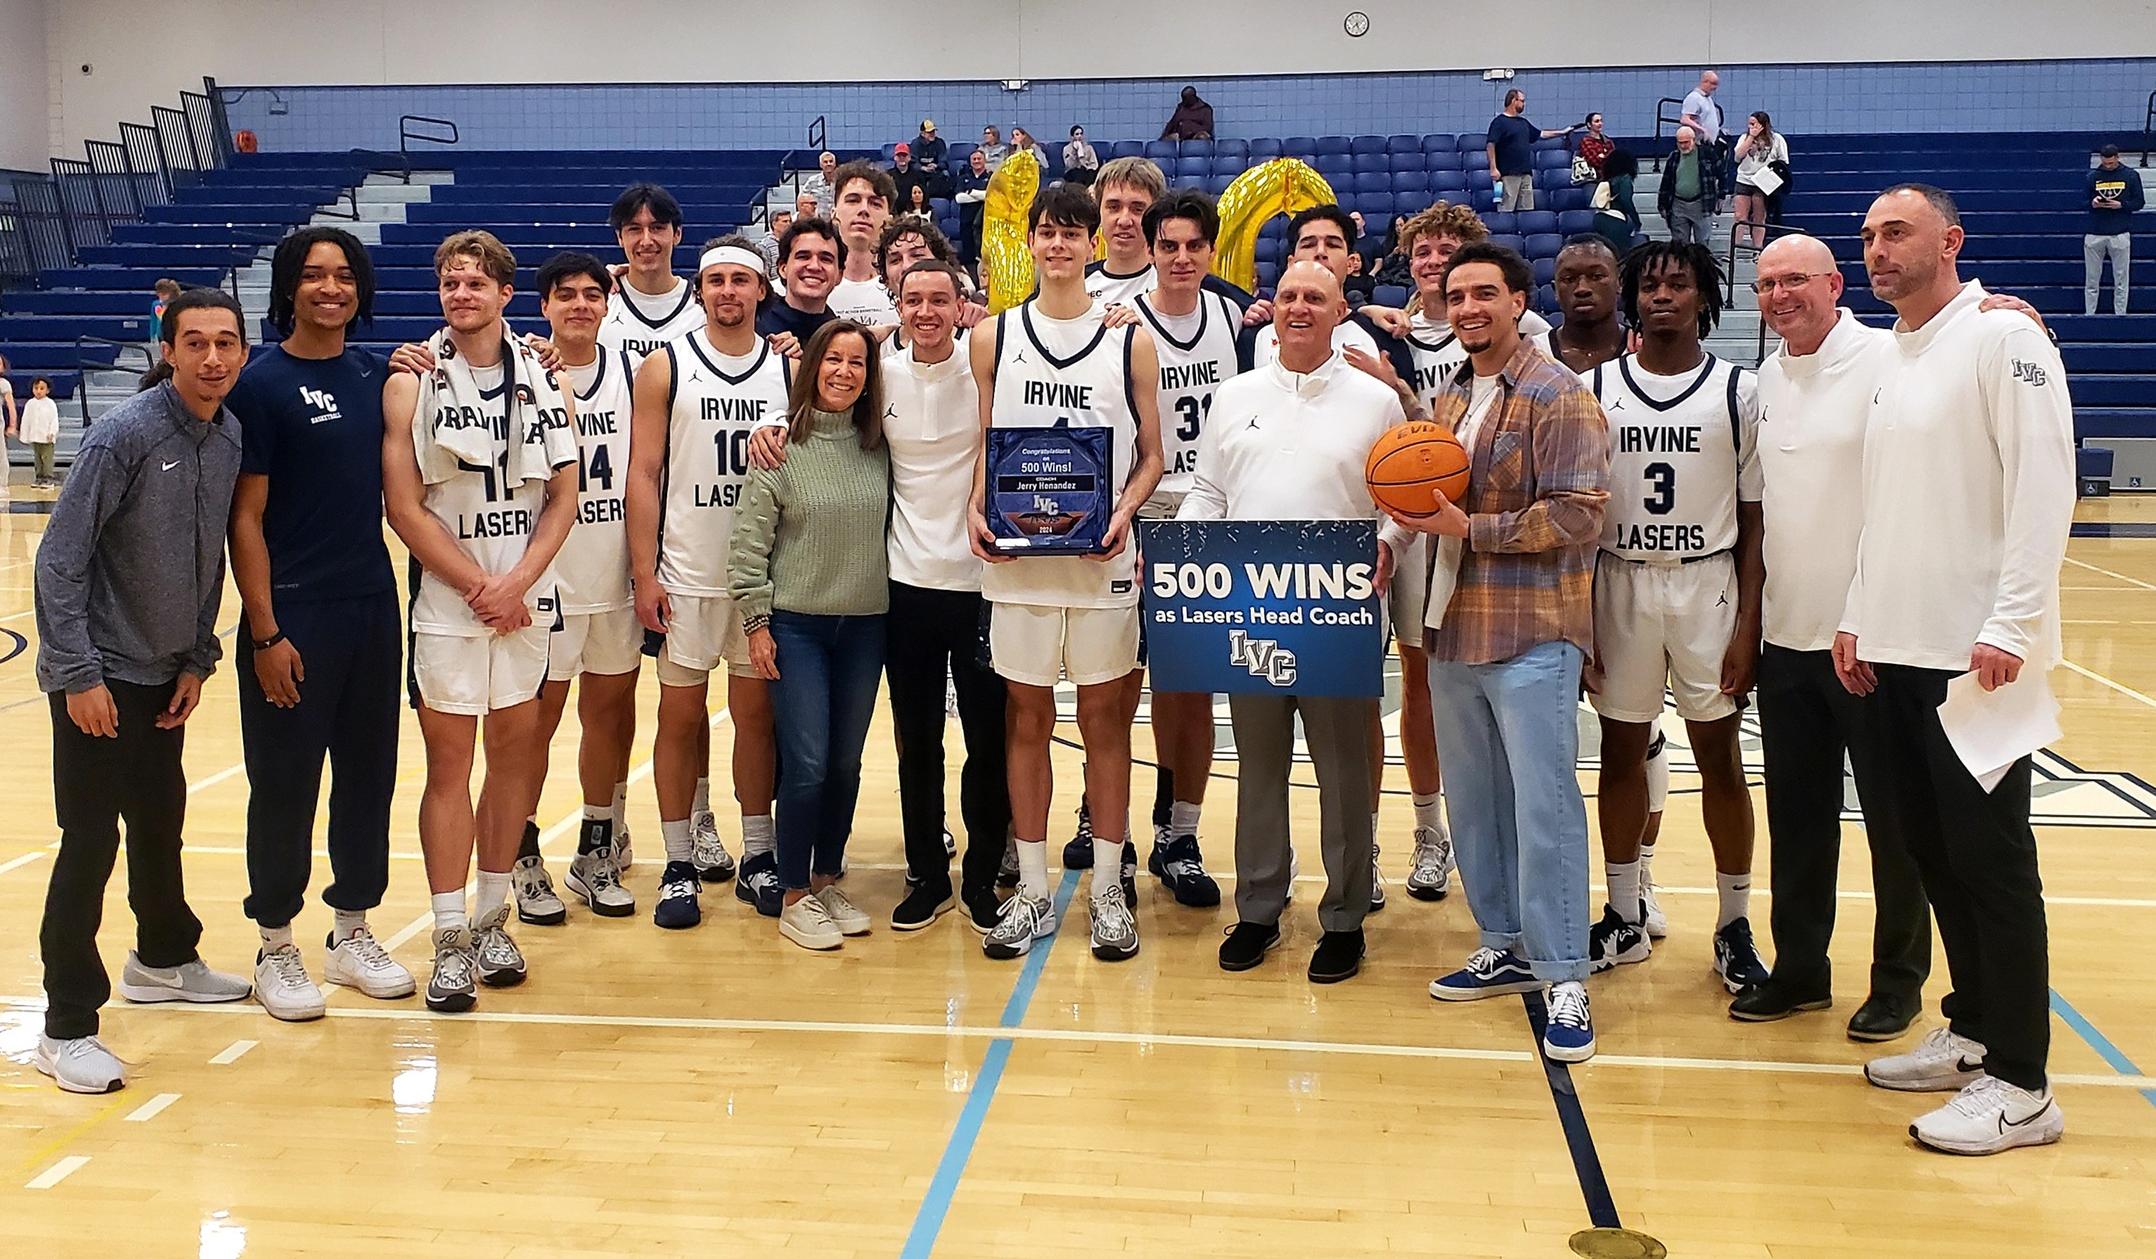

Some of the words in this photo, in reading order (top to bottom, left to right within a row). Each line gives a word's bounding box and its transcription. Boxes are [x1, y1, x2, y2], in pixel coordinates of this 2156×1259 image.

[1161, 360, 1221, 390] IRVINE
[2011, 359, 2046, 387] IVC
[299, 385, 338, 412] IVC
[701, 397, 768, 421] IRVINE
[1024, 380, 1093, 411] IRVINE
[576, 411, 618, 437] VINE
[714, 429, 751, 475] 10
[1620, 426, 1702, 453] IRVINE
[1021, 462, 1040, 473] 500
[1042, 461, 1072, 473] Wins!
[1017, 481, 1037, 492] Jerry
[1039, 481, 1077, 490] Henandez
[1643, 462, 1676, 515] 3
[1033, 494, 1059, 516] IVC
[1616, 523, 1705, 551] LASERS
[1152, 563, 1232, 599] 500
[1244, 562, 1374, 600] WINS
[1155, 609, 1176, 623] as
[1182, 606, 1244, 624] Lasers
[1250, 606, 1304, 625] Head
[1309, 606, 1373, 625] Coach
[1228, 629, 1298, 687] IVC
